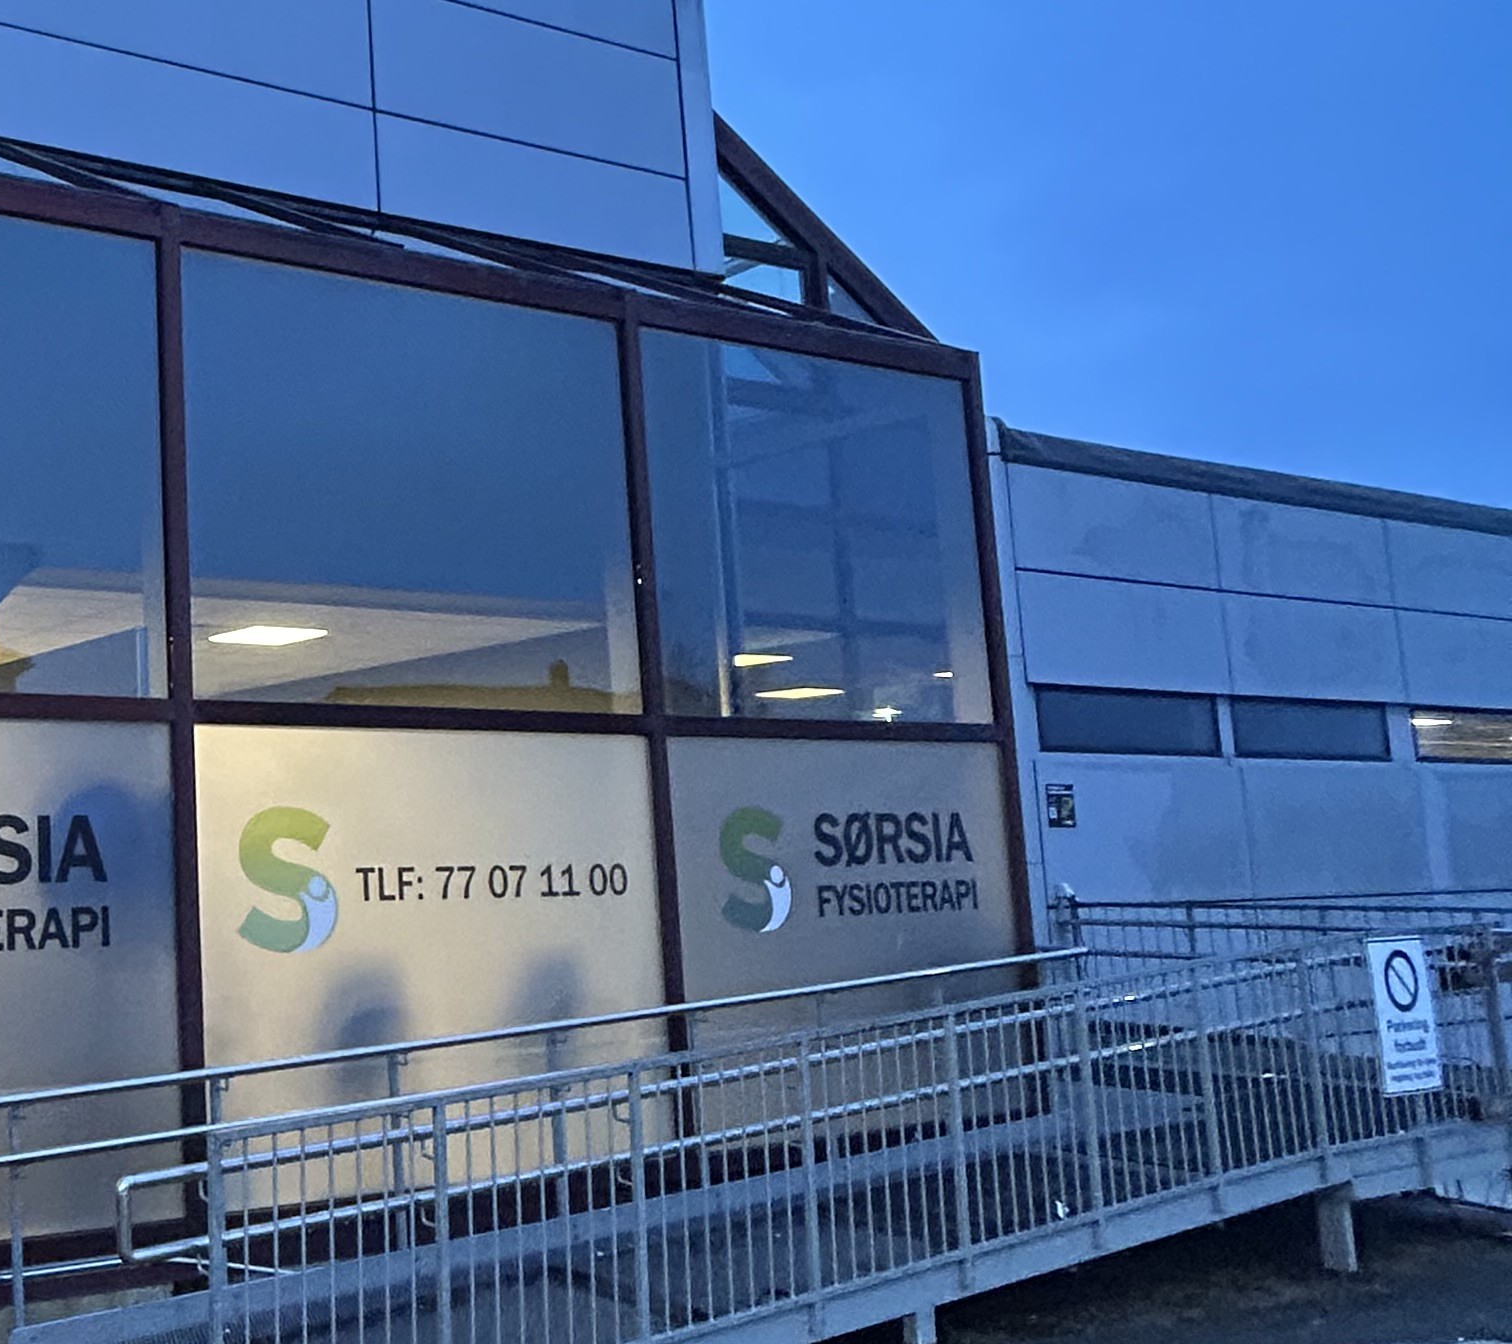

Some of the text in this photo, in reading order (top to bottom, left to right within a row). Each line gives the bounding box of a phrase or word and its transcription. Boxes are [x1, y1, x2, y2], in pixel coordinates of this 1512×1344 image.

[813, 810, 975, 868] SØRSIA
[355, 862, 628, 902] TLF: 77 07 11 00
[815, 878, 979, 918] FYSIOTERAPI
